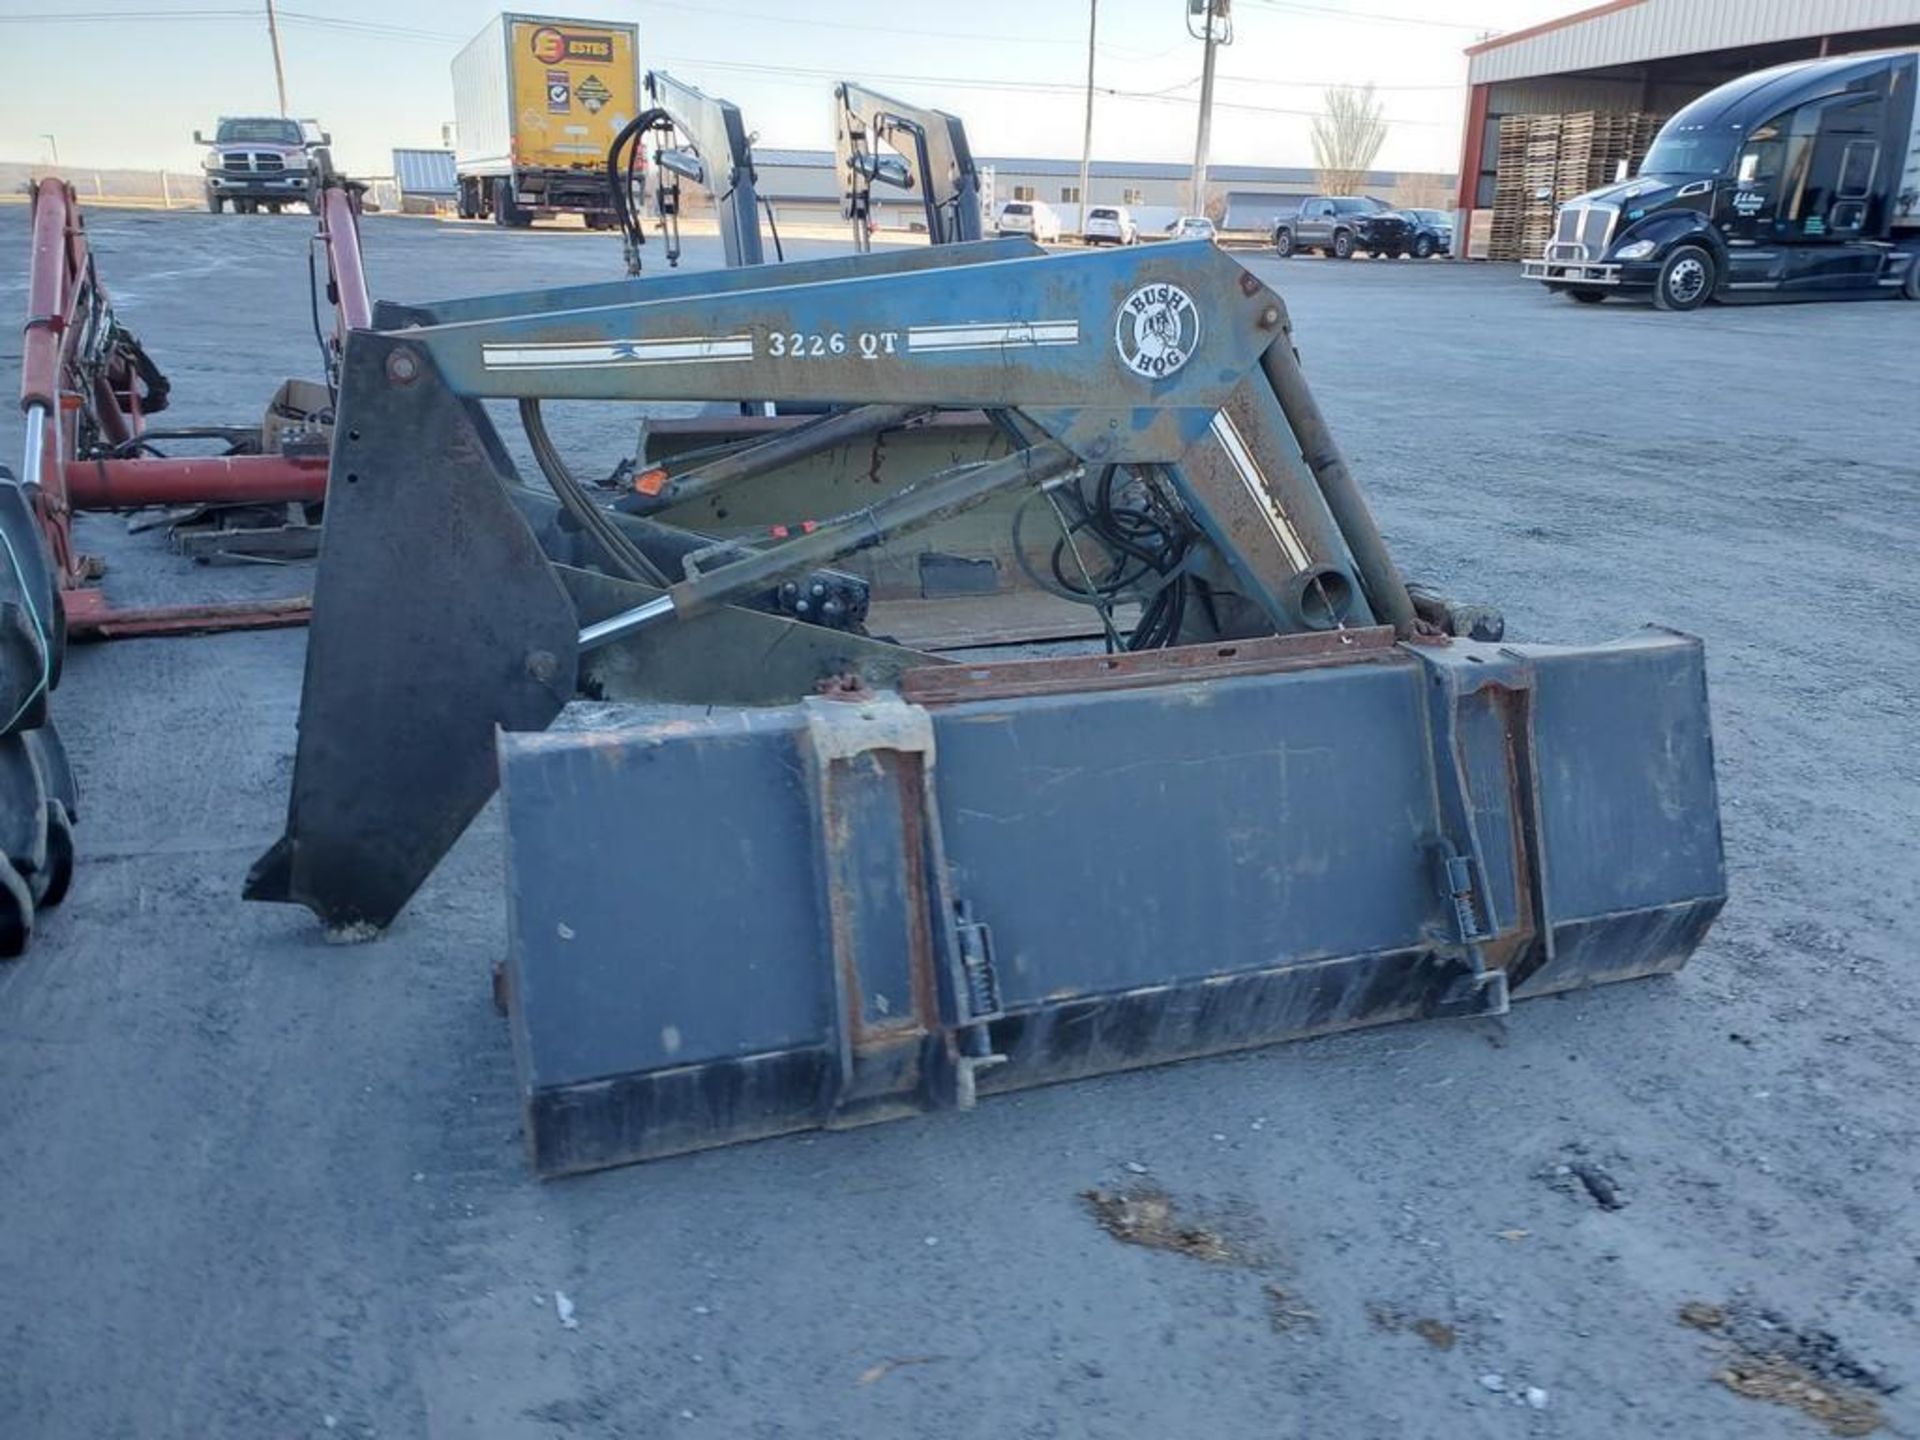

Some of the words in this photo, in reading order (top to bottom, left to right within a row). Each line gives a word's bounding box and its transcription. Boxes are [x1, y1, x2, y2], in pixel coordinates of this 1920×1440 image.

[1130, 287, 1185, 314] BUSH
[768, 332, 845, 357] 3226
[859, 332, 898, 359] QT
[1137, 350, 1180, 373] HOG
